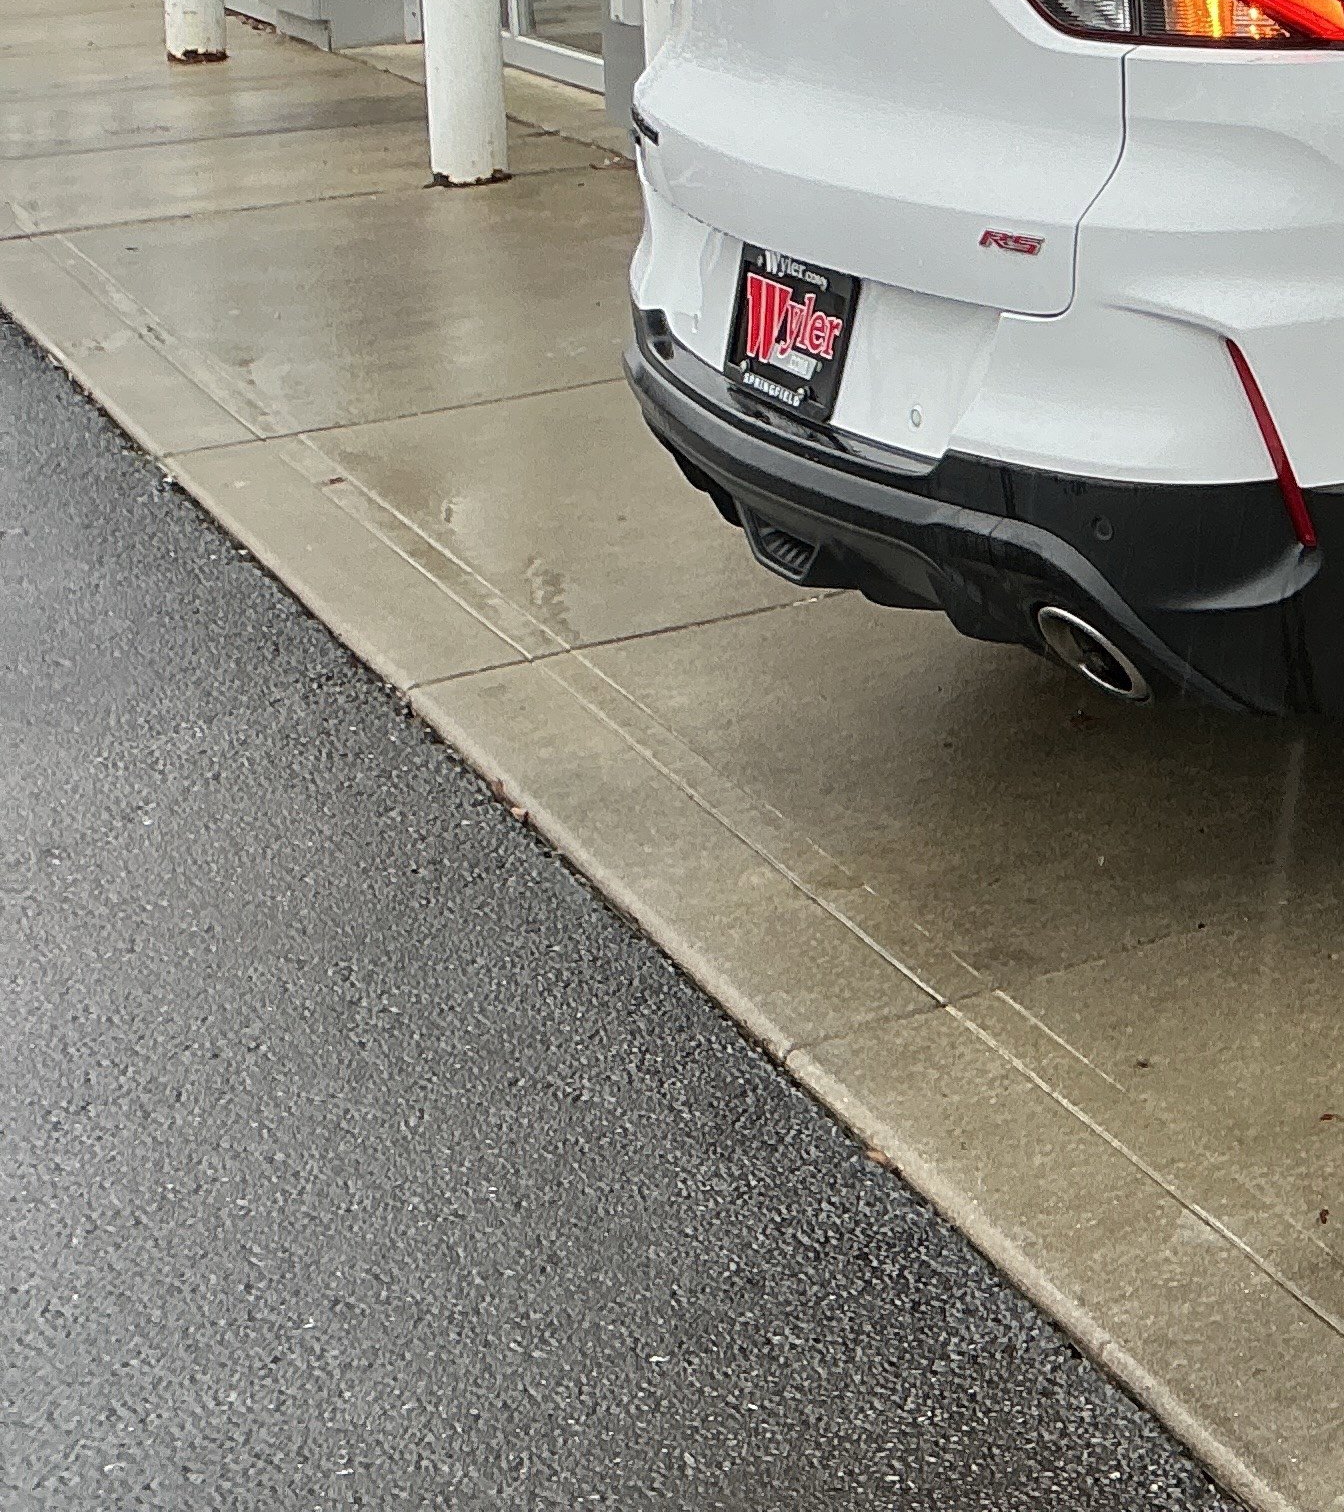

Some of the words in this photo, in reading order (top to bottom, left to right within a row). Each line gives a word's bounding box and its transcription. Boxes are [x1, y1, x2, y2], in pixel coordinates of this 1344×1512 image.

[979, 228, 1045, 256] RS
[747, 272, 843, 363] Wyler
[743, 371, 802, 407] SPRINGFIELD
